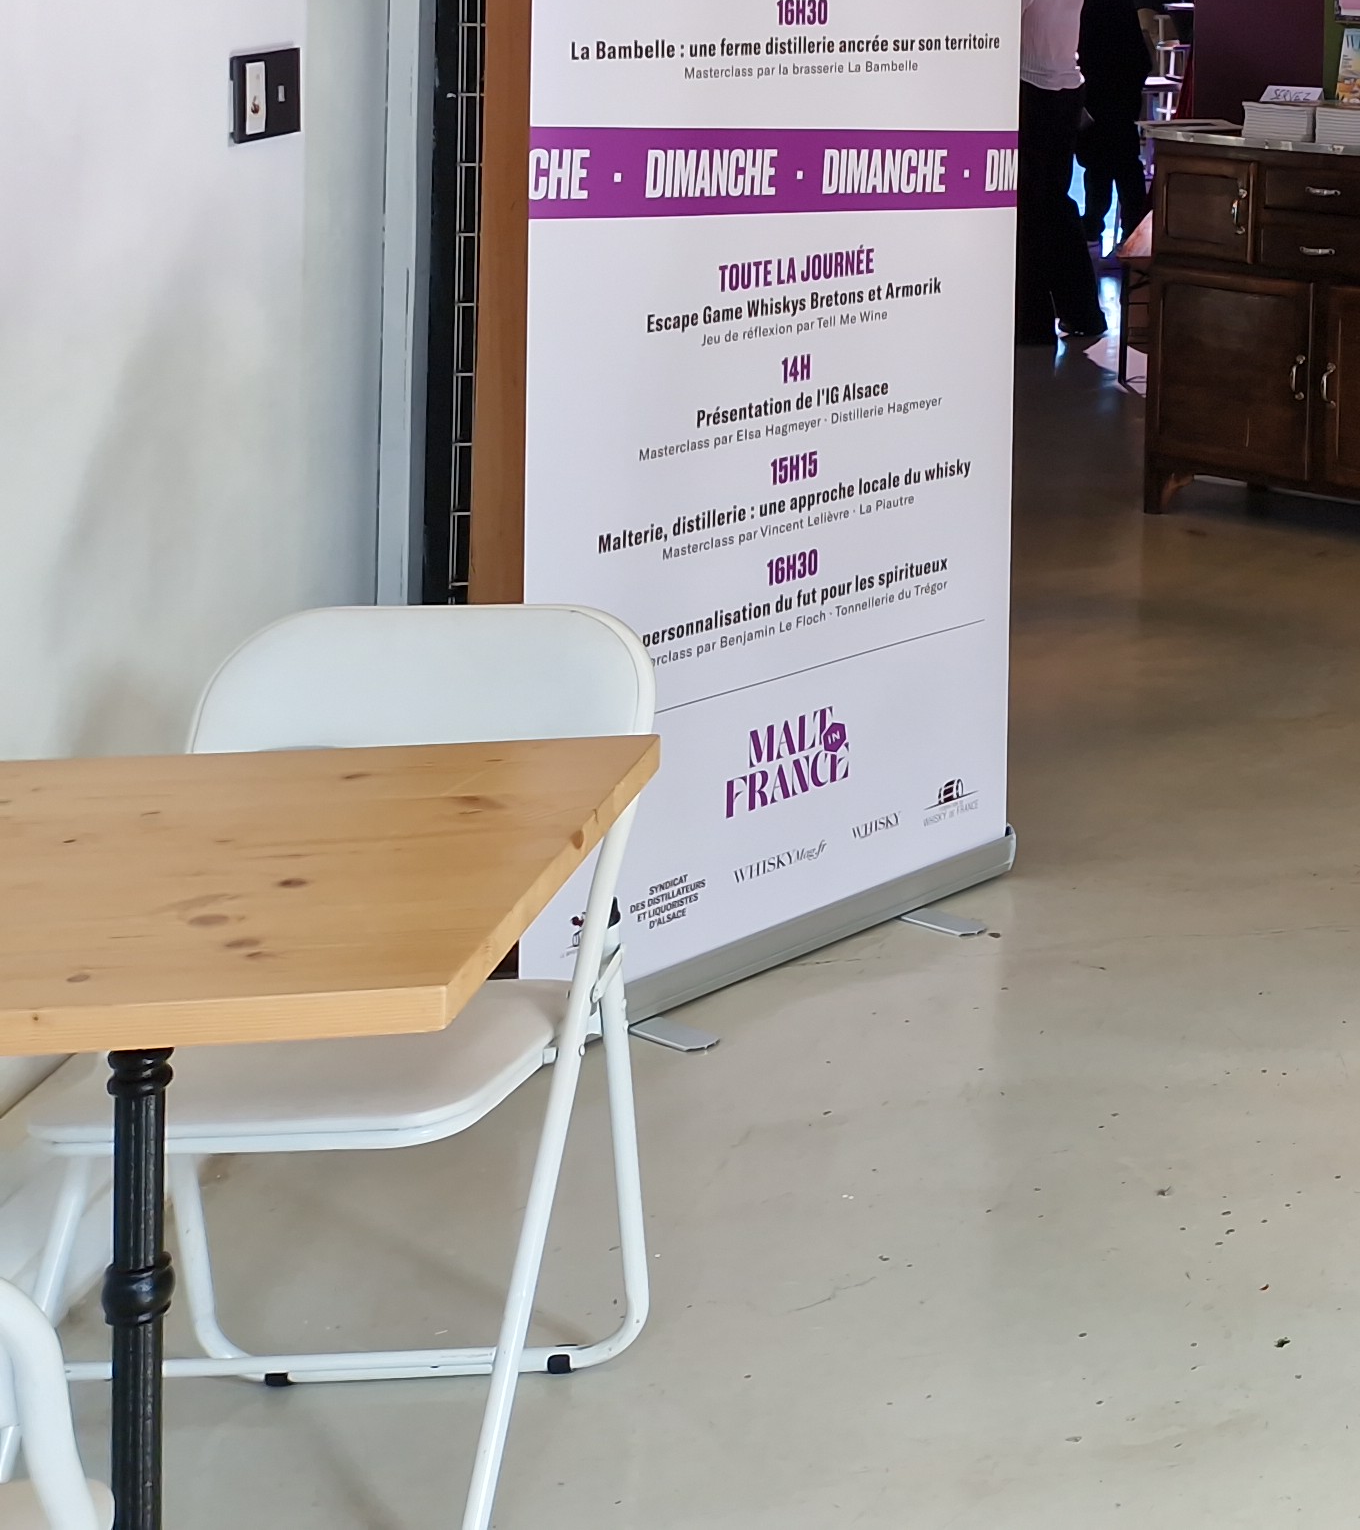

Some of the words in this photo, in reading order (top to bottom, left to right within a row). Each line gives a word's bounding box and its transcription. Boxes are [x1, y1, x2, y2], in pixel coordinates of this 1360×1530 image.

[572, 42, 589, 60] La
[597, 40, 675, 59] Bambelle
[690, 44, 716, 57] une
[721, 38, 761, 56] ferme
[766, 36, 834, 55] distillerie
[839, 35, 888, 52] ancrée
[893, 39, 915, 51] sur
[919, 39, 941, 51] son
[945, 33, 999, 50] territoire
[685, 65, 753, 79] Masterclass
[757, 67, 775, 79] par
[779, 64, 788, 75] la
[793, 62, 843, 75] brasserie
[848, 62, 860, 72] La
[866, 60, 918, 72] Bambelle
[645, 149, 777, 198] DIMANCHE
[822, 149, 947, 194] DIMANCHE
[719, 260, 772, 292] TOUTE
[777, 257, 796, 285] LA
[801, 245, 874, 282] JOURNÉE
[647, 312, 698, 333] Escape
[703, 306, 742, 324] Game
[747, 296, 806, 318] Whiskys
[811, 291, 863, 309] Bretons
[868, 286, 882, 301] et
[886, 277, 941, 299] Armorik
[702, 334, 720, 346] Jeu
[725, 330, 738, 342] de
[743, 324, 792, 339] réflexion
[797, 321, 814, 334] par
[817, 315, 835, 328] Tell
[840, 313, 856, 325] Me
[860, 310, 887, 322] Wine
[782, 354, 810, 383] 14H
[697, 398, 793, 430] Présentation
[796, 392, 812, 410] de
[817, 386, 839, 406] l'IG
[843, 383, 888, 402] Alsace
[639, 439, 709, 461] Masterclass
[714, 435, 733, 449] par
[737, 429, 761, 442] Elsa
[766, 418, 821, 436] Hagmeyer
[832, 406, 883, 424] Distillerie
[888, 398, 942, 414] Hagmeyer
[771, 451, 817, 485] 15H15
[599, 521, 669, 555] Malterie,
[673, 505, 746, 539] distillerie
[760, 500, 785, 517] une
[790, 482, 854, 514] approche
[859, 472, 899, 495] locale
[905, 468, 920, 485] du
[925, 459, 970, 481] whisky
[663, 536, 734, 560] Masterclass
[739, 531, 758, 545] par
[760, 519, 803, 537] Vincent
[808, 510, 849, 527] Lelièvre
[860, 504, 871, 515] La
[767, 549, 817, 586] 16H30
[776, 594, 792, 613] du
[797, 588, 816, 607] fut
[821, 582, 852, 605] pour
[856, 575, 874, 592] les
[879, 558, 947, 591] spiritueux
[697, 642, 716, 657] par
[720, 625, 775, 648] Benjamin
[780, 621, 792, 633] Le
[796, 611, 825, 628] Floch
[835, 594, 894, 617] Tonnellerie
[898, 589, 911, 600] du
[914, 581, 947, 597] Trégor
[749, 706, 833, 768] MALT
[827, 731, 840, 744] IN
[726, 742, 849, 818] FRANCE
[852, 812, 900, 838] WHISKY
[630, 901, 645, 913] DES
[648, 879, 706, 907] DISTILLATEURS
[649, 874, 688, 895] SYNDICAT
[637, 912, 647, 922] ET
[648, 893, 698, 918] LIQUORISTES
[649, 908, 686, 929] D'ALSACE
